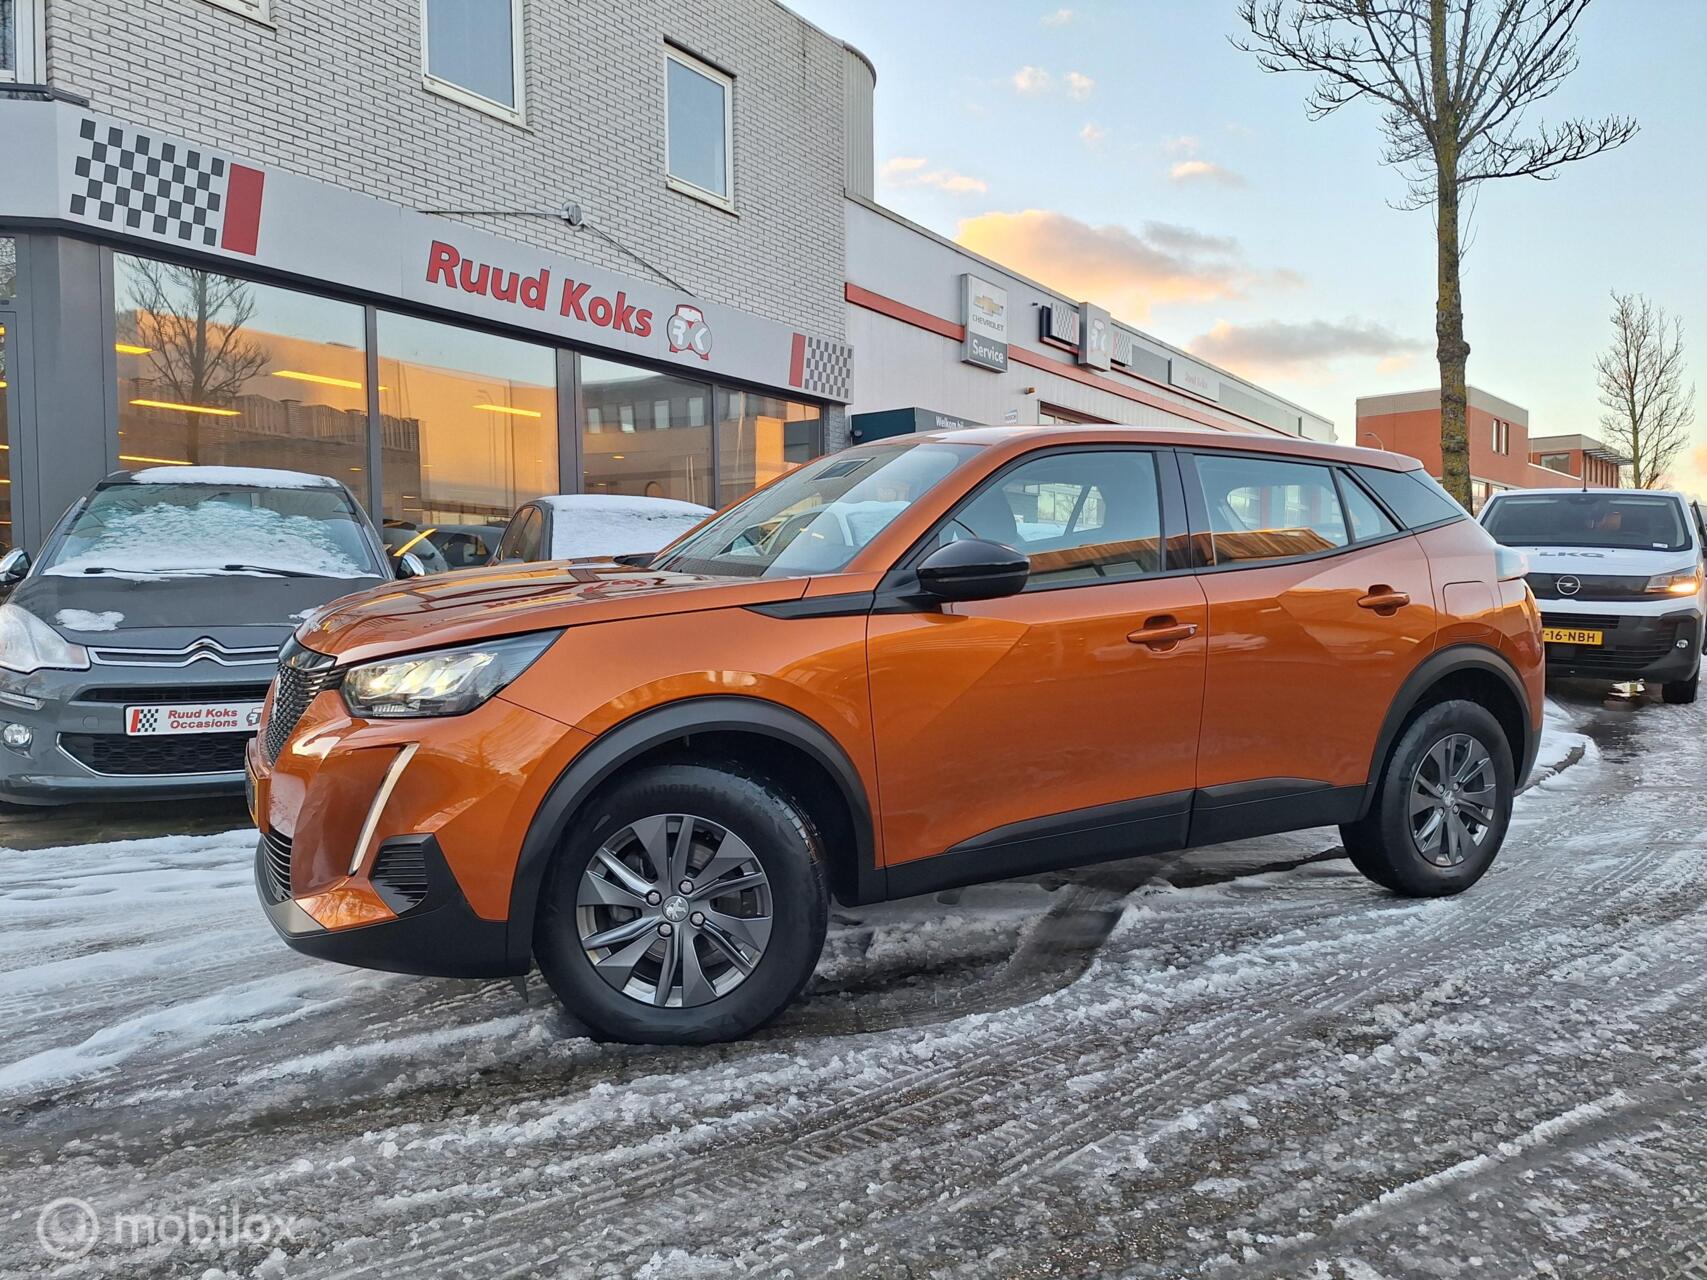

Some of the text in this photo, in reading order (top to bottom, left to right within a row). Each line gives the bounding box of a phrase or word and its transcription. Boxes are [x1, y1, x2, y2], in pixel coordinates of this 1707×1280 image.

[426, 240, 653, 338] Ruud Koks
[972, 314, 1004, 331] CHEVROLET
[972, 339, 1004, 363] Service
[935, 415, 957, 429] Welkom
[168, 708, 238, 719] Ruud Koks
[169, 719, 238, 729] Occasions
